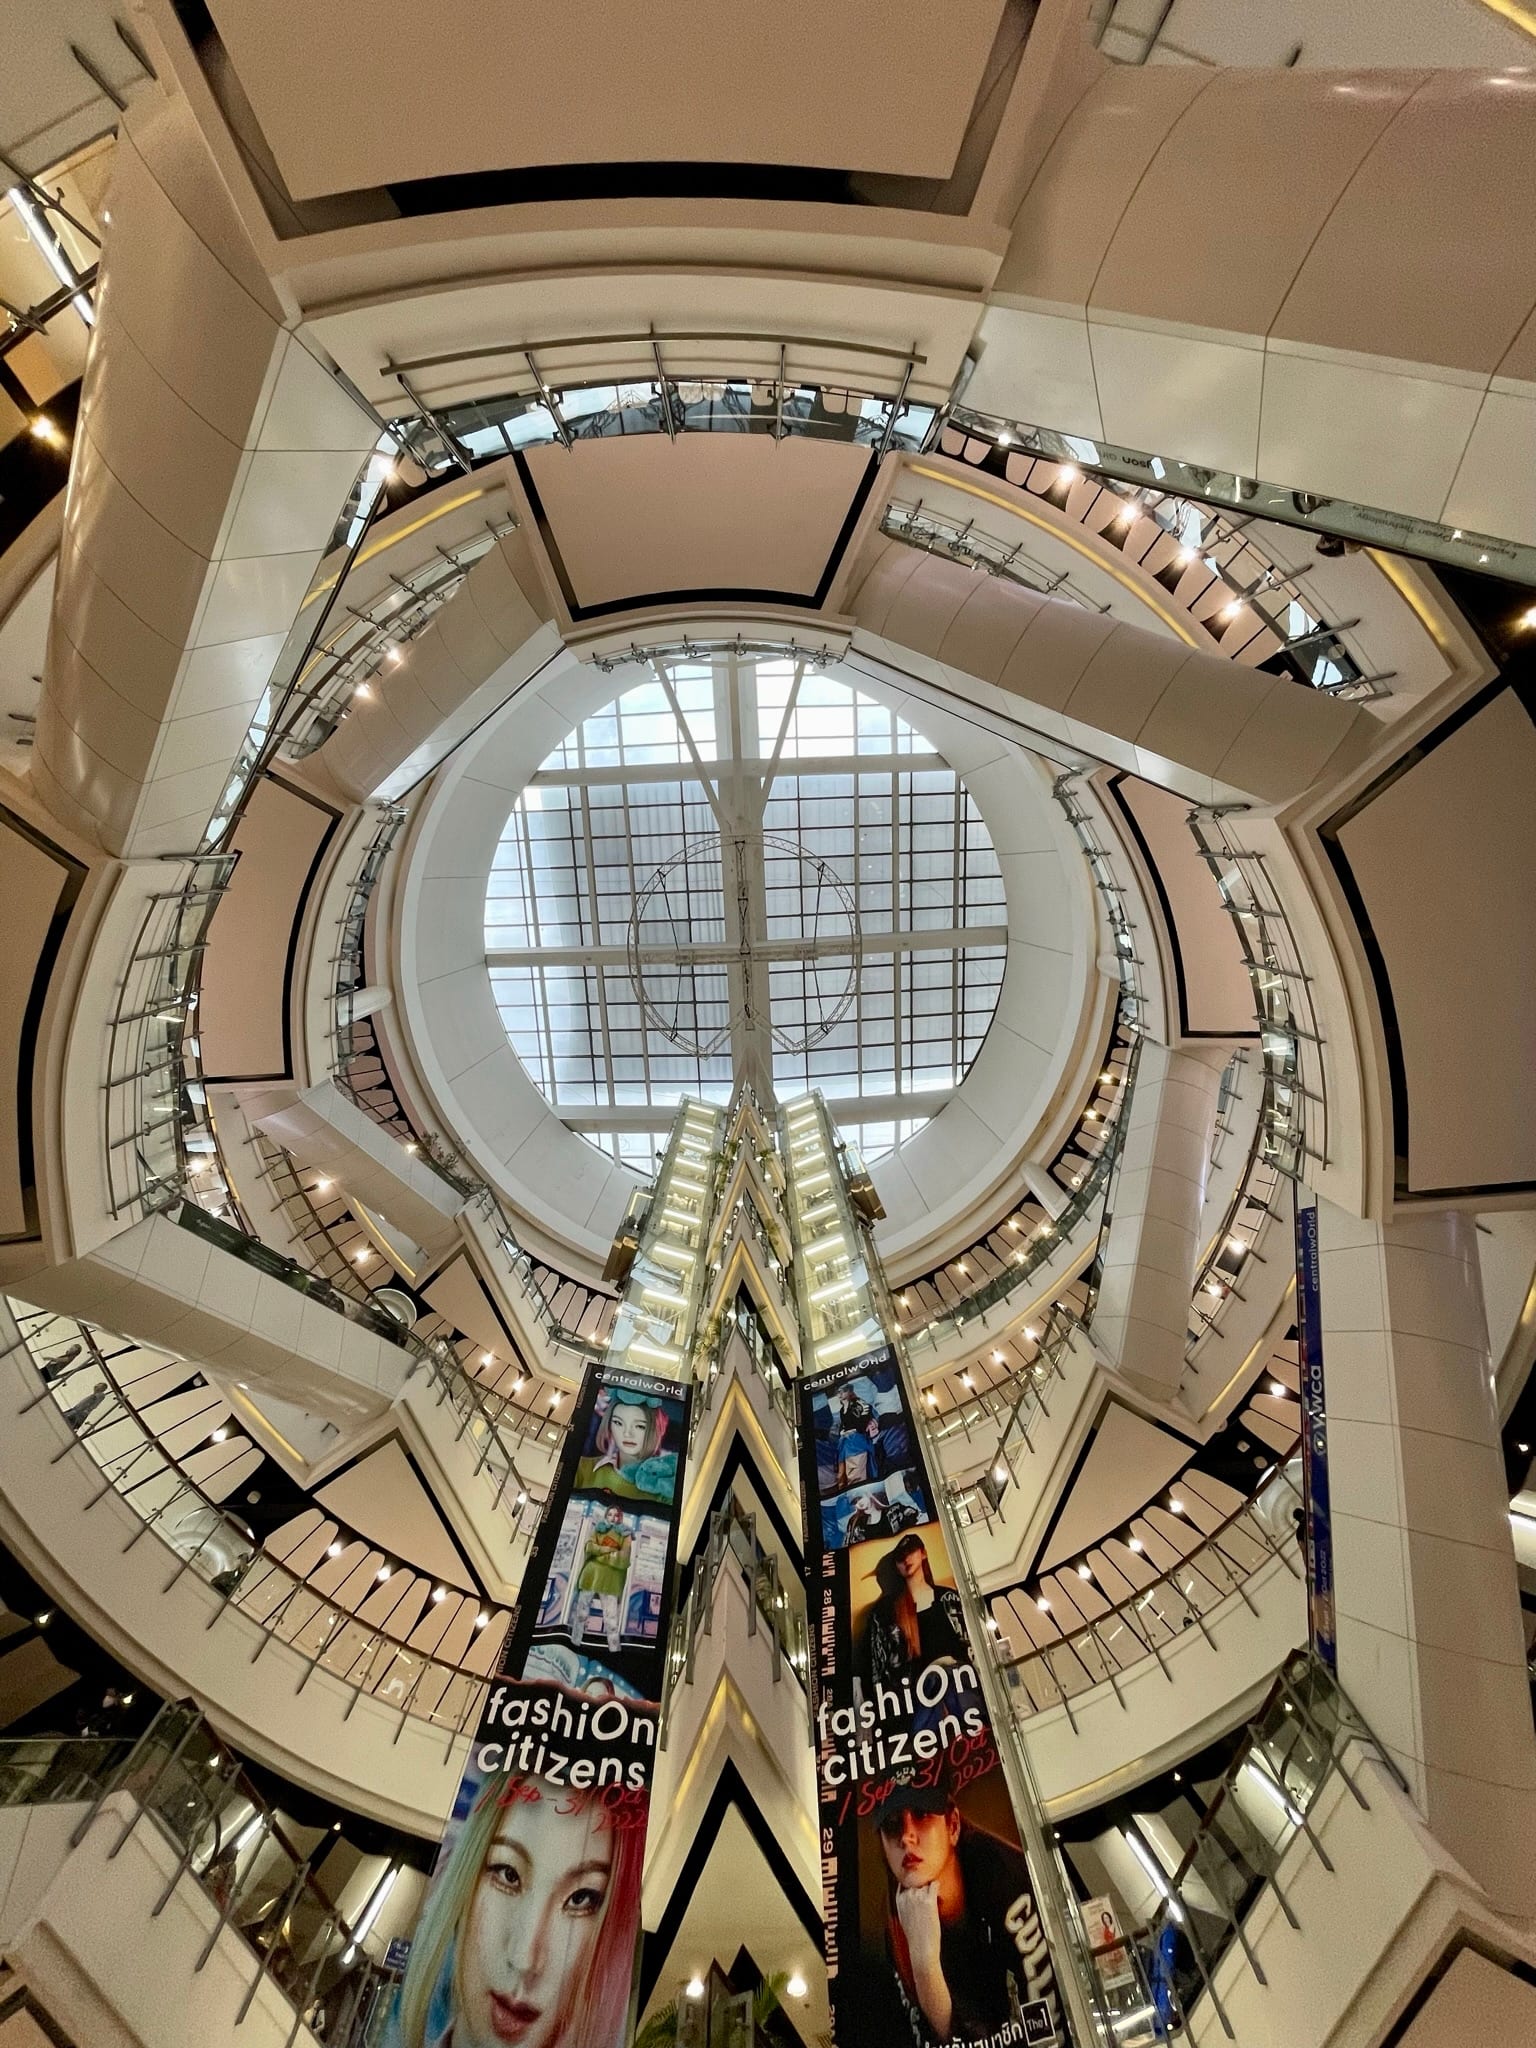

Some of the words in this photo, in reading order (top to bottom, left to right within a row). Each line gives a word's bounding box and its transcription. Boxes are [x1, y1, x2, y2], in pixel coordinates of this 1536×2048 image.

[1121, 456, 1153, 469] yson
[594, 1372, 685, 1396] centralwOrld
[823, 1589, 832, 1605] 28
[486, 1687, 656, 1746] fashiOn
[817, 1664, 978, 1741] fashiOn
[477, 1731, 646, 1791] citizens
[824, 1706, 984, 1786] citizens
[823, 1827, 833, 1854] 29
